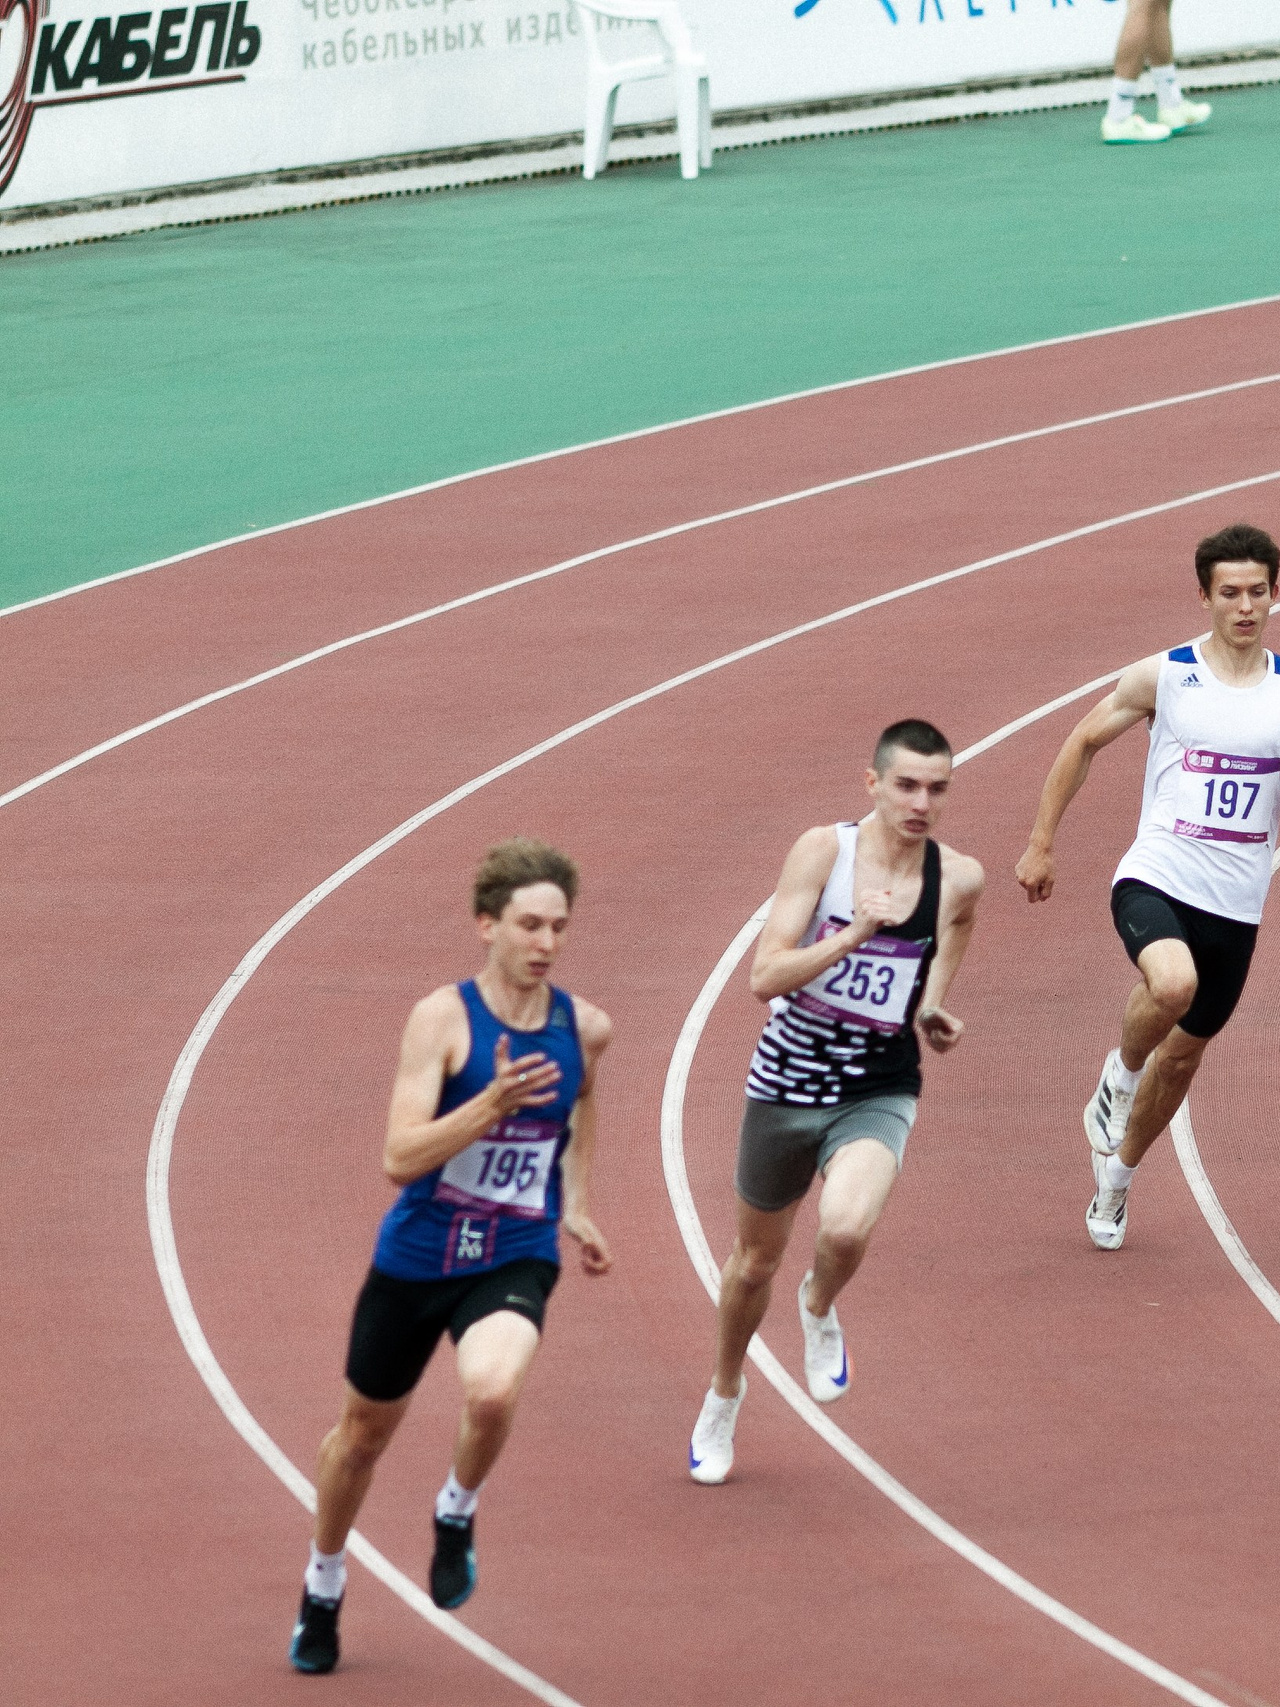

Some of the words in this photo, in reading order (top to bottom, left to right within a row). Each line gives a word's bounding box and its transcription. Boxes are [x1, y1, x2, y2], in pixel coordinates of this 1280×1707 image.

[31, 0, 262, 95] КАБЕЛЬ
[302, 21, 486, 70] кабельных
[1204, 778, 1261, 820] 197
[824, 957, 895, 1006] 253
[477, 1147, 540, 1194] 195
